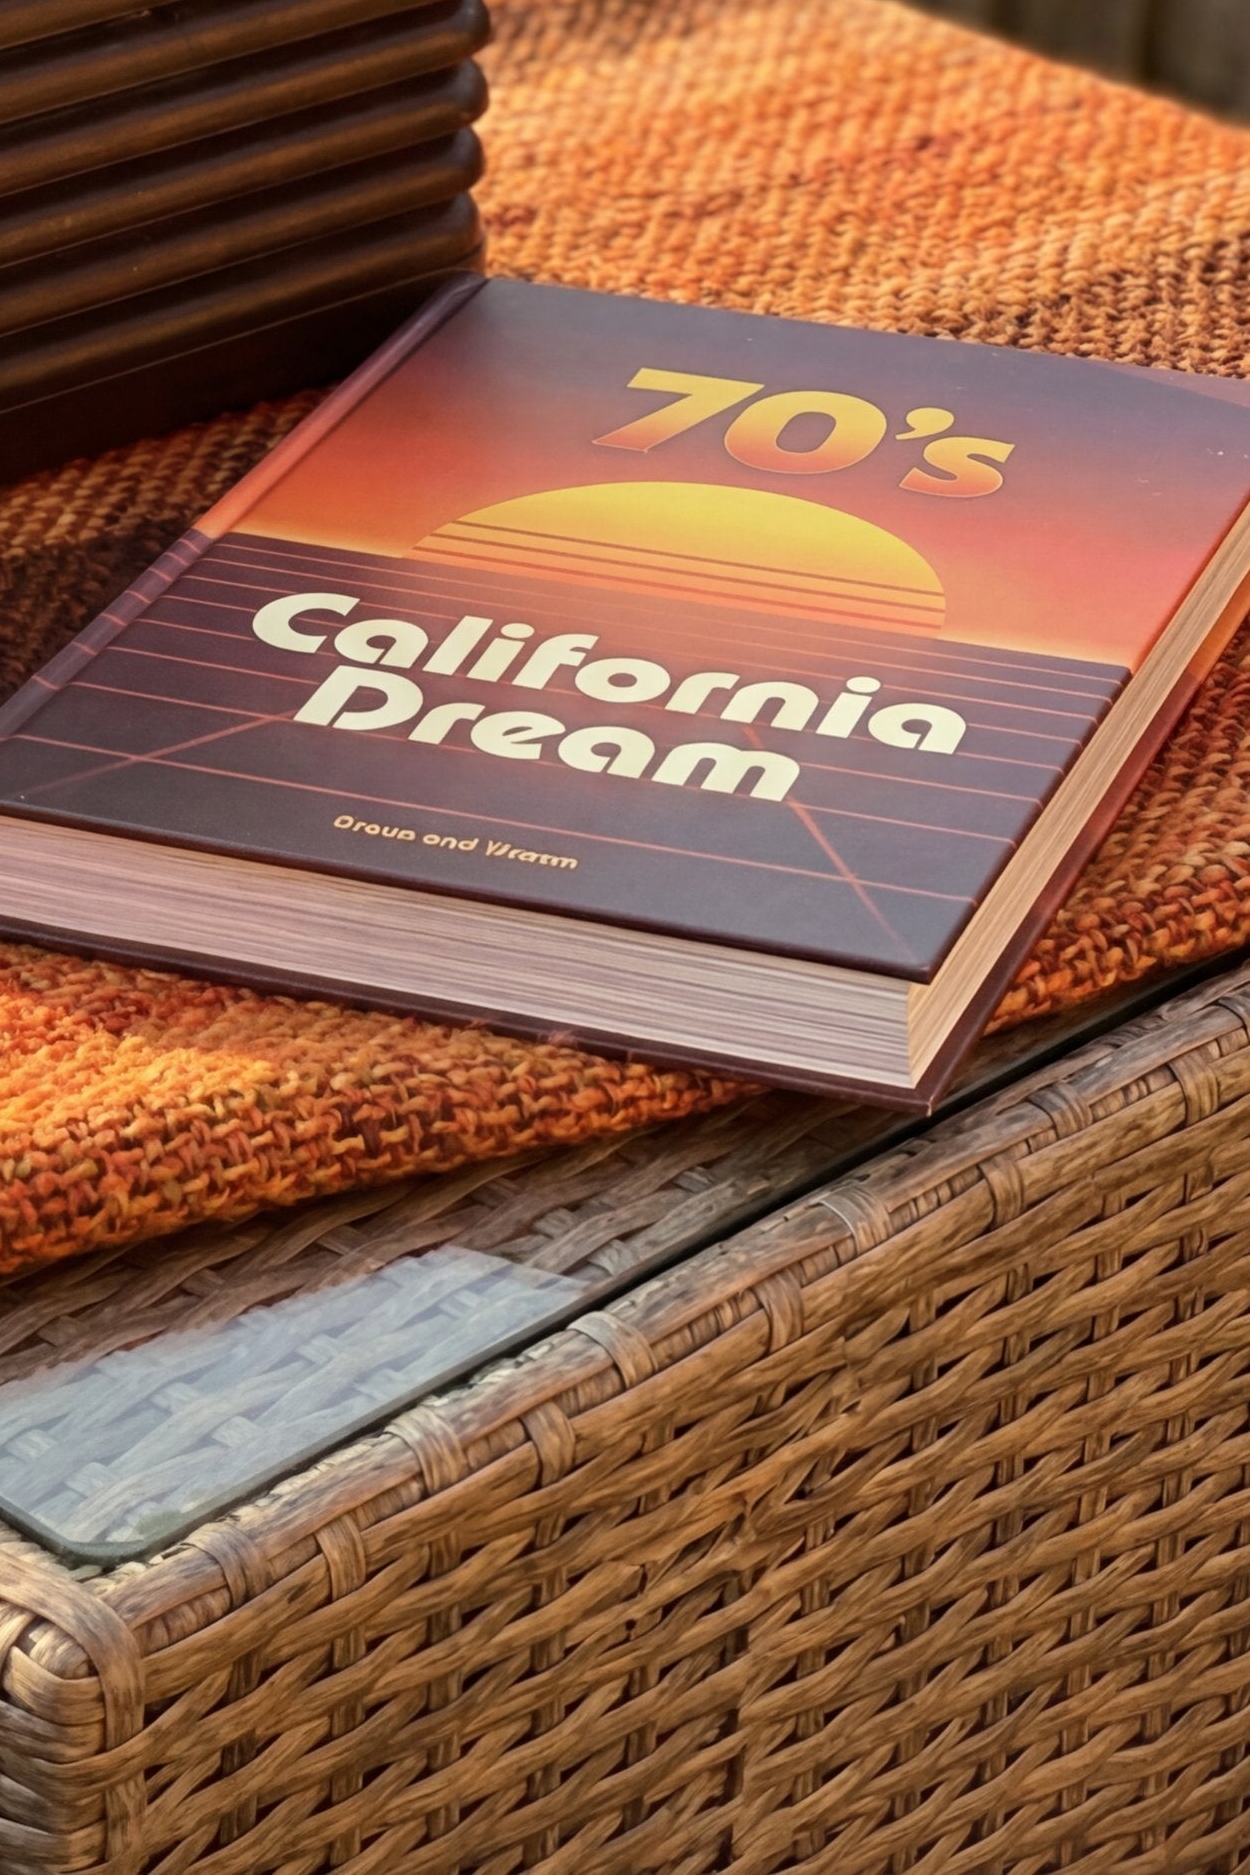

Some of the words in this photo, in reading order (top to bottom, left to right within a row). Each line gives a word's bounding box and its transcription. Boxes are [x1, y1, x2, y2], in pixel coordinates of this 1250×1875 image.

[592, 367, 1016, 498] 70's
[252, 592, 968, 755] California
[293, 664, 801, 803] Dream
